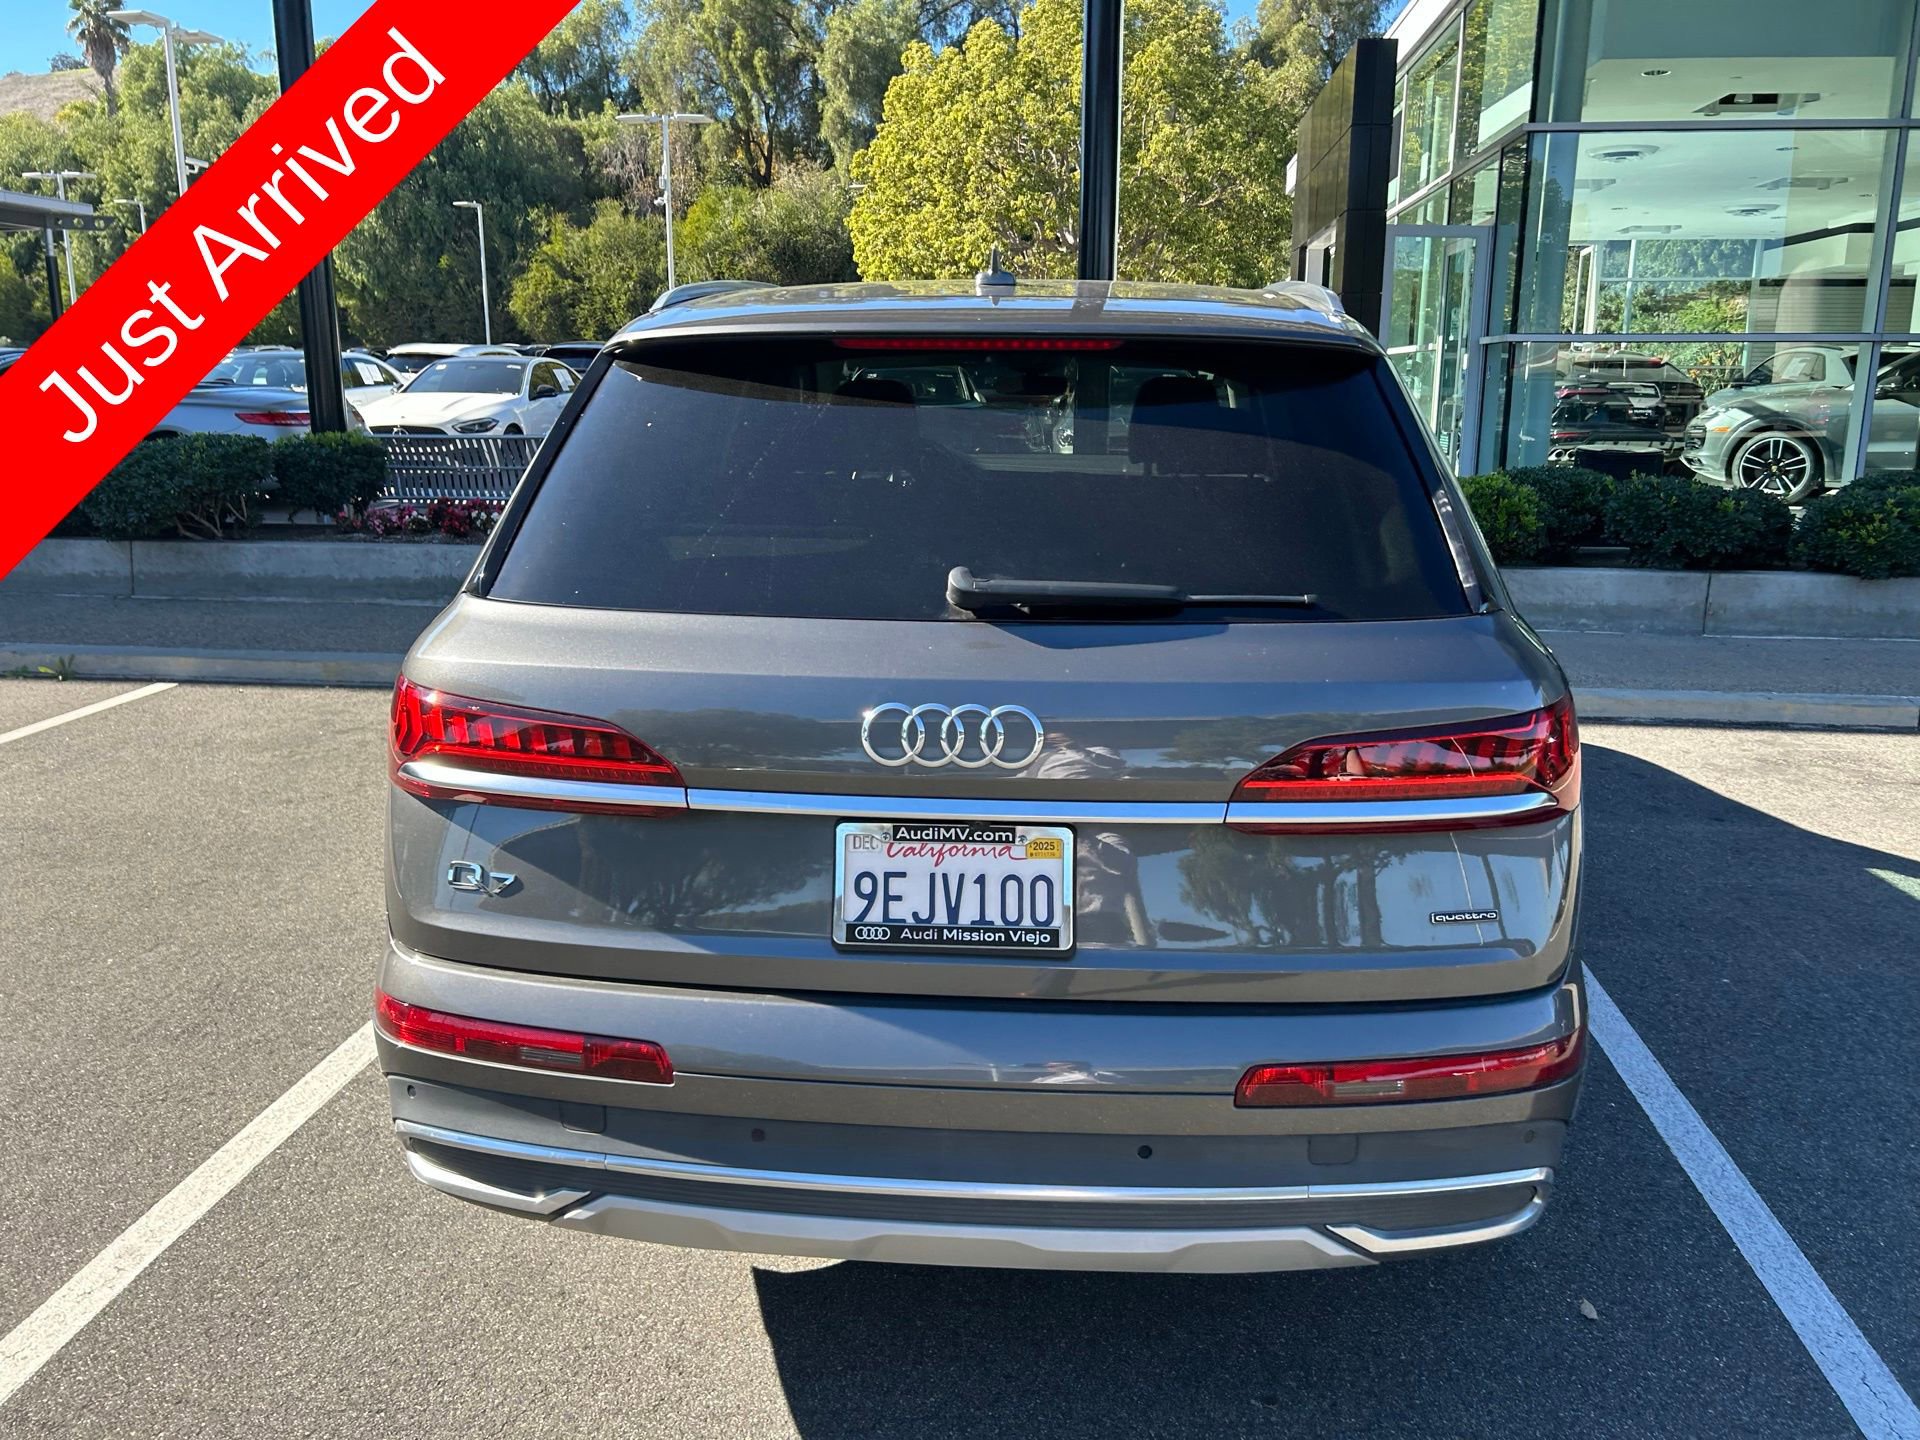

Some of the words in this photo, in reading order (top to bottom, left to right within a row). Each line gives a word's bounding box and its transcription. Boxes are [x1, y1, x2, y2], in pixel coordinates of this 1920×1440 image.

[896, 826, 1013, 842] AudiMV.com
[853, 835, 879, 850] DEC
[1033, 841, 1056, 851] 2025
[886, 842, 1027, 868] California
[447, 860, 517, 897] Q7
[853, 871, 1055, 927] 9EJV100
[1435, 912, 1497, 923] quattro
[900, 928, 938, 941] Audi
[943, 928, 1005, 943] Mission
[1009, 930, 1051, 945] Viejo
